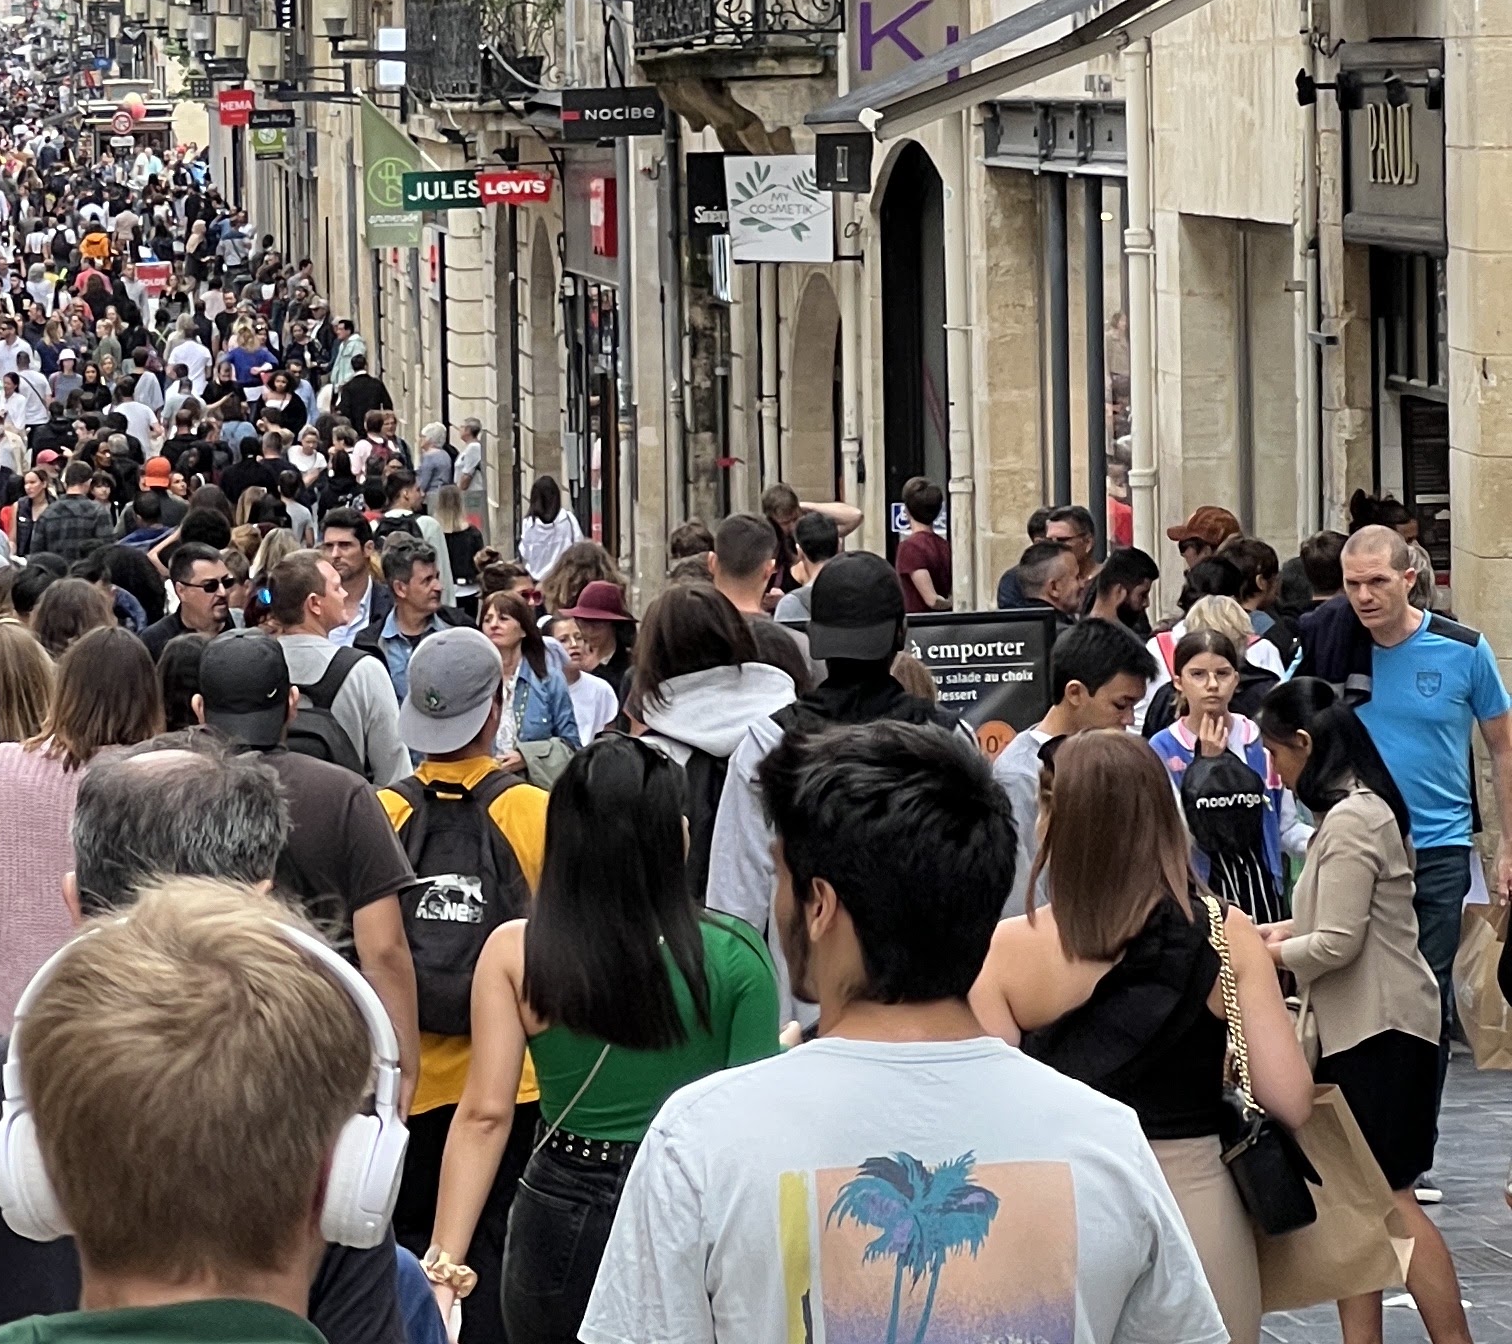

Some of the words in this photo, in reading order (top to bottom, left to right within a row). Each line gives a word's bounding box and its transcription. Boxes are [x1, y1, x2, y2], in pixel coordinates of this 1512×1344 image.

[220, 100, 253, 112] HEMA
[1368, 103, 1419, 185] PAUL
[407, 179, 482, 201] JULES
[771, 193, 789, 202] MY
[749, 203, 813, 215] COSMETIK
[910, 639, 922, 659] à
[928, 641, 1025, 663] emporter
[946, 671, 981, 684] salade
[984, 672, 999, 683] au
[1001, 669, 1033, 682] choix
[1196, 793, 1261, 809] moov'ngo
